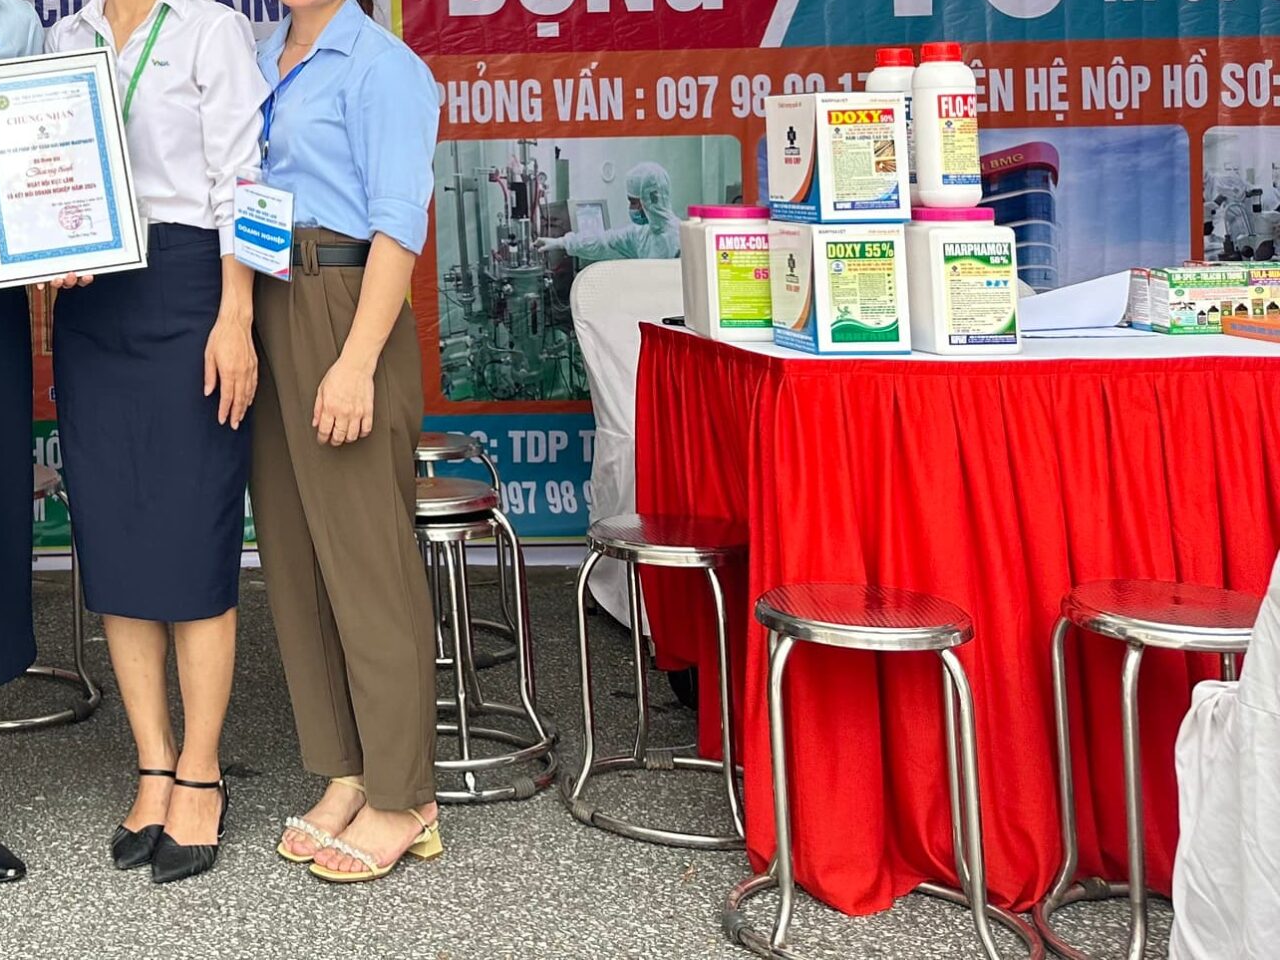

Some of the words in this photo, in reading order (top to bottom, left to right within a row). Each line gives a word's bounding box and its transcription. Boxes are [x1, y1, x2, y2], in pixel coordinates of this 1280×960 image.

[552, 60, 625, 123] VẤN
[656, 76, 719, 121] 097
[1025, 56, 1070, 121] HỆ
[1082, 56, 1152, 120] NỘP
[1162, 48, 1208, 110] HỒ
[830, 110, 882, 125] DOXY
[719, 235, 768, 250] AMOX-COL
[827, 242, 861, 258] DOXY
[864, 242, 894, 258] 55%
[944, 243, 1010, 256] MARPHAMOX
[508, 430, 569, 463] TDP
[545, 480, 578, 514] 98
